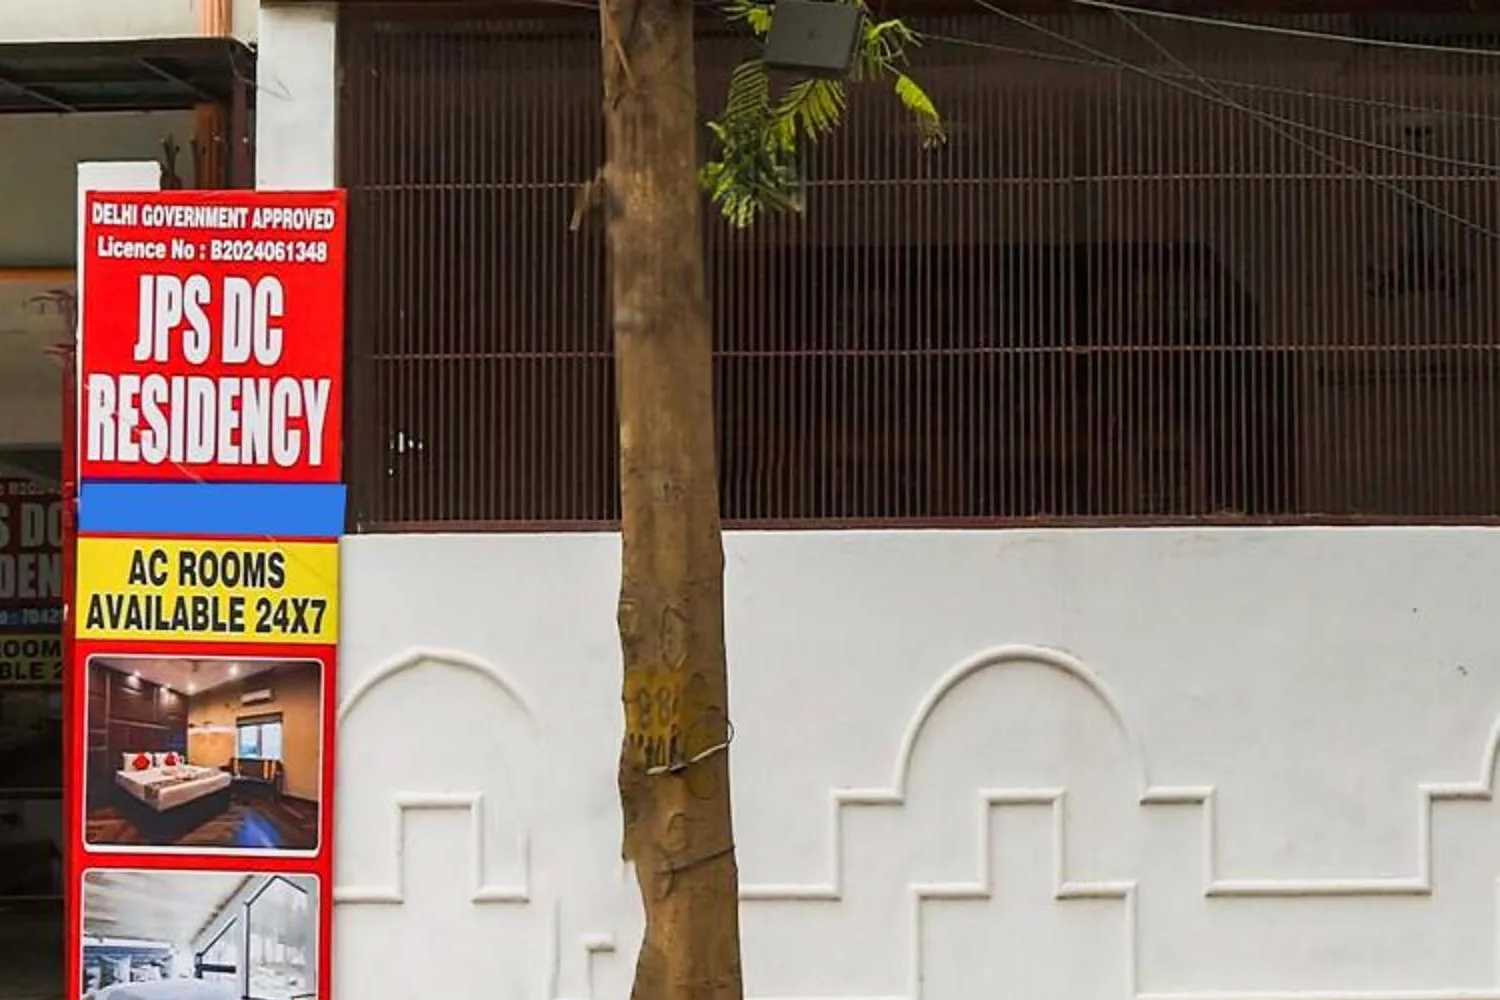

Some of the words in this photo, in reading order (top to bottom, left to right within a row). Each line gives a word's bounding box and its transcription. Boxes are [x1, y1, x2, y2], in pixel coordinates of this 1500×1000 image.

[92, 203, 138, 225] DELHI
[142, 205, 249, 229] GOVERNMENT
[252, 208, 335, 230] APPROVED
[98, 236, 166, 259] Licence
[172, 239, 194, 259] No
[210, 240, 328, 262] B2024061348
[133, 274, 211, 364] JPS
[221, 276, 284, 365] DC
[87, 374, 331, 466] RESIDENCY
[128, 549, 168, 586] AC
[178, 551, 285, 589] ROOMS
[86, 594, 245, 633] AVAILABLE
[255, 598, 327, 634] 24X7
